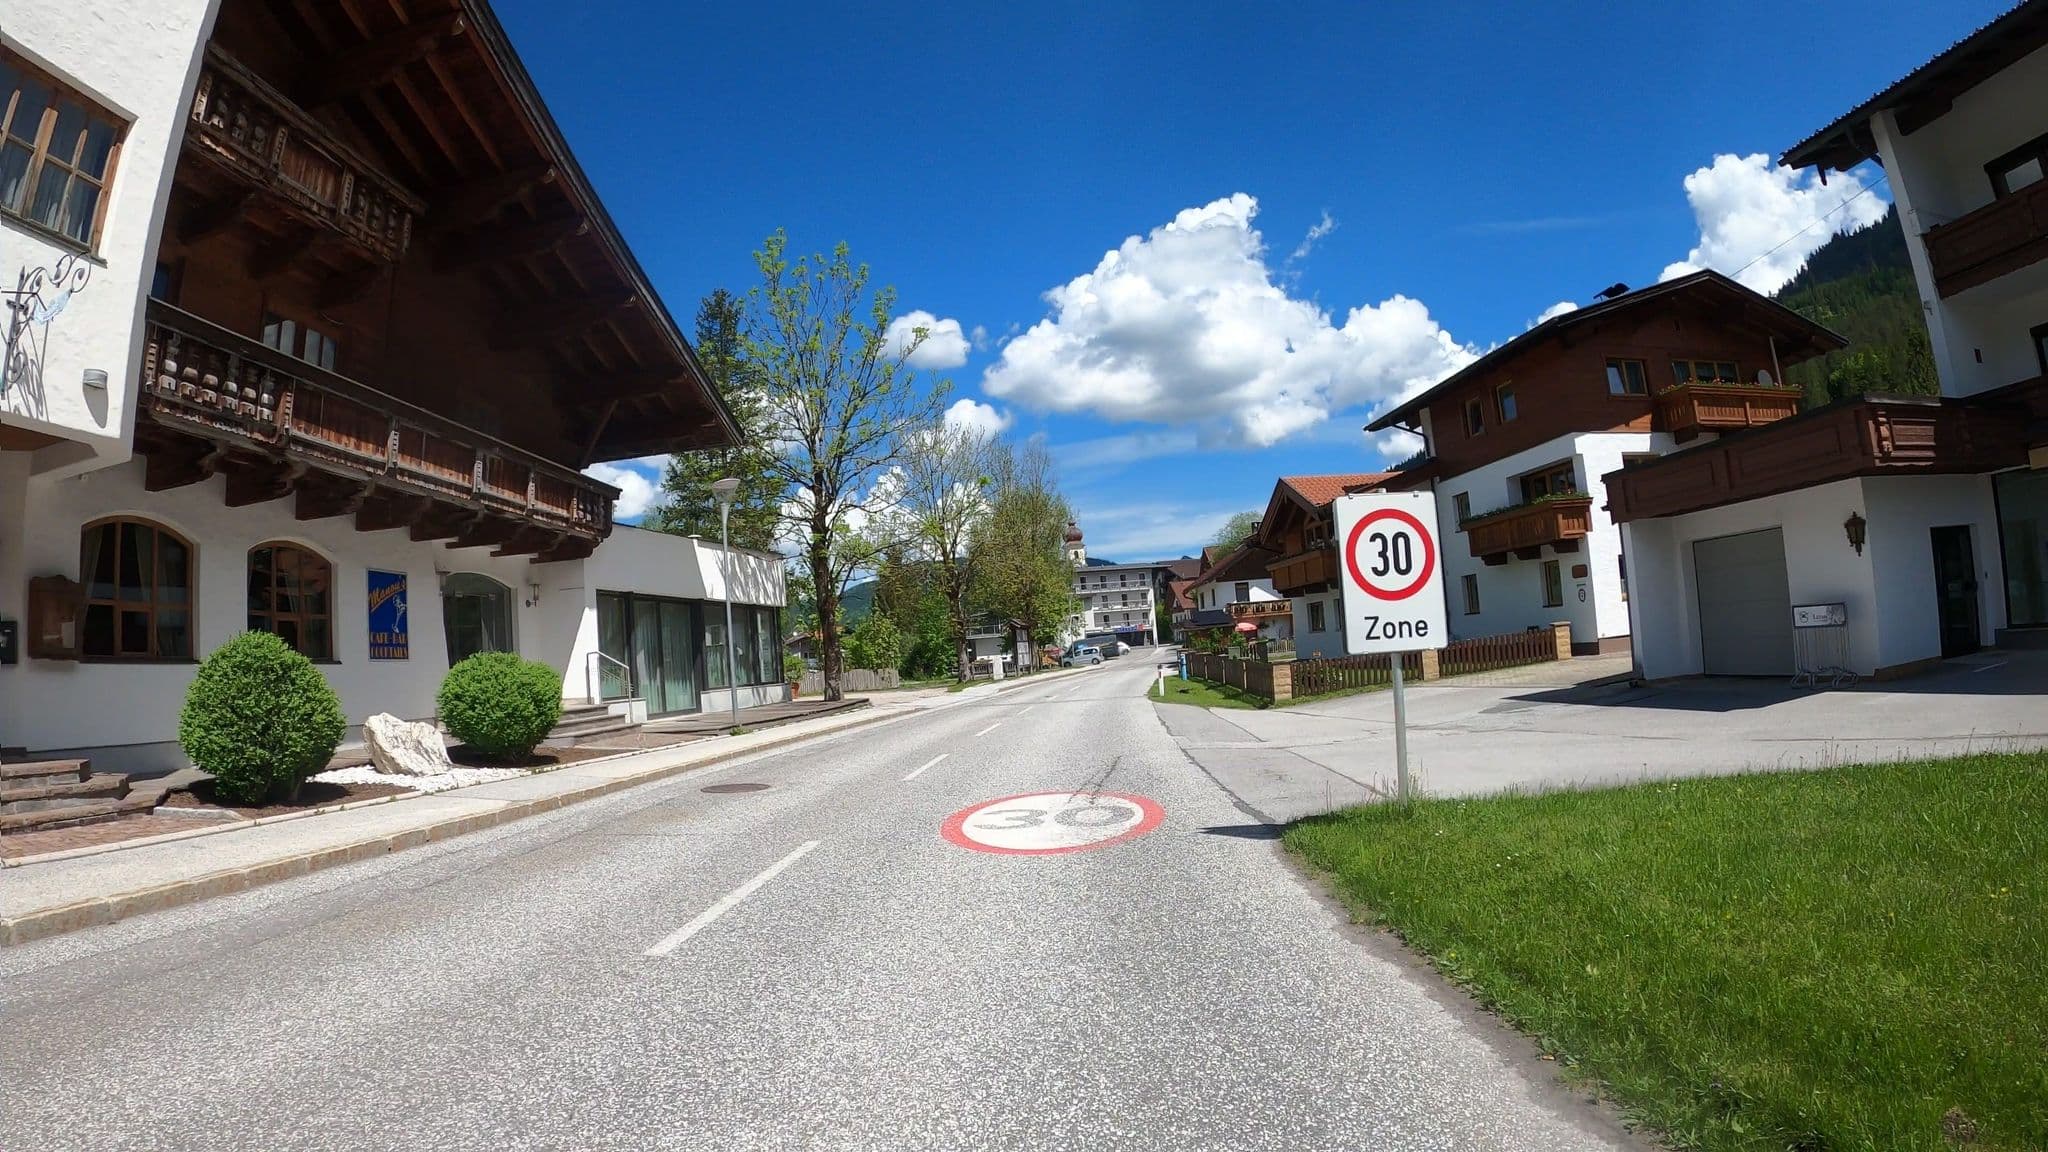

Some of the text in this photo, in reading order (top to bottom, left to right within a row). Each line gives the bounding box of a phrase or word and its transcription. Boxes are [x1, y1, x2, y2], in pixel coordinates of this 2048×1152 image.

[1369, 531, 1412, 577] 30
[1364, 616, 1429, 641] Zone
[972, 805, 1136, 830] 30
